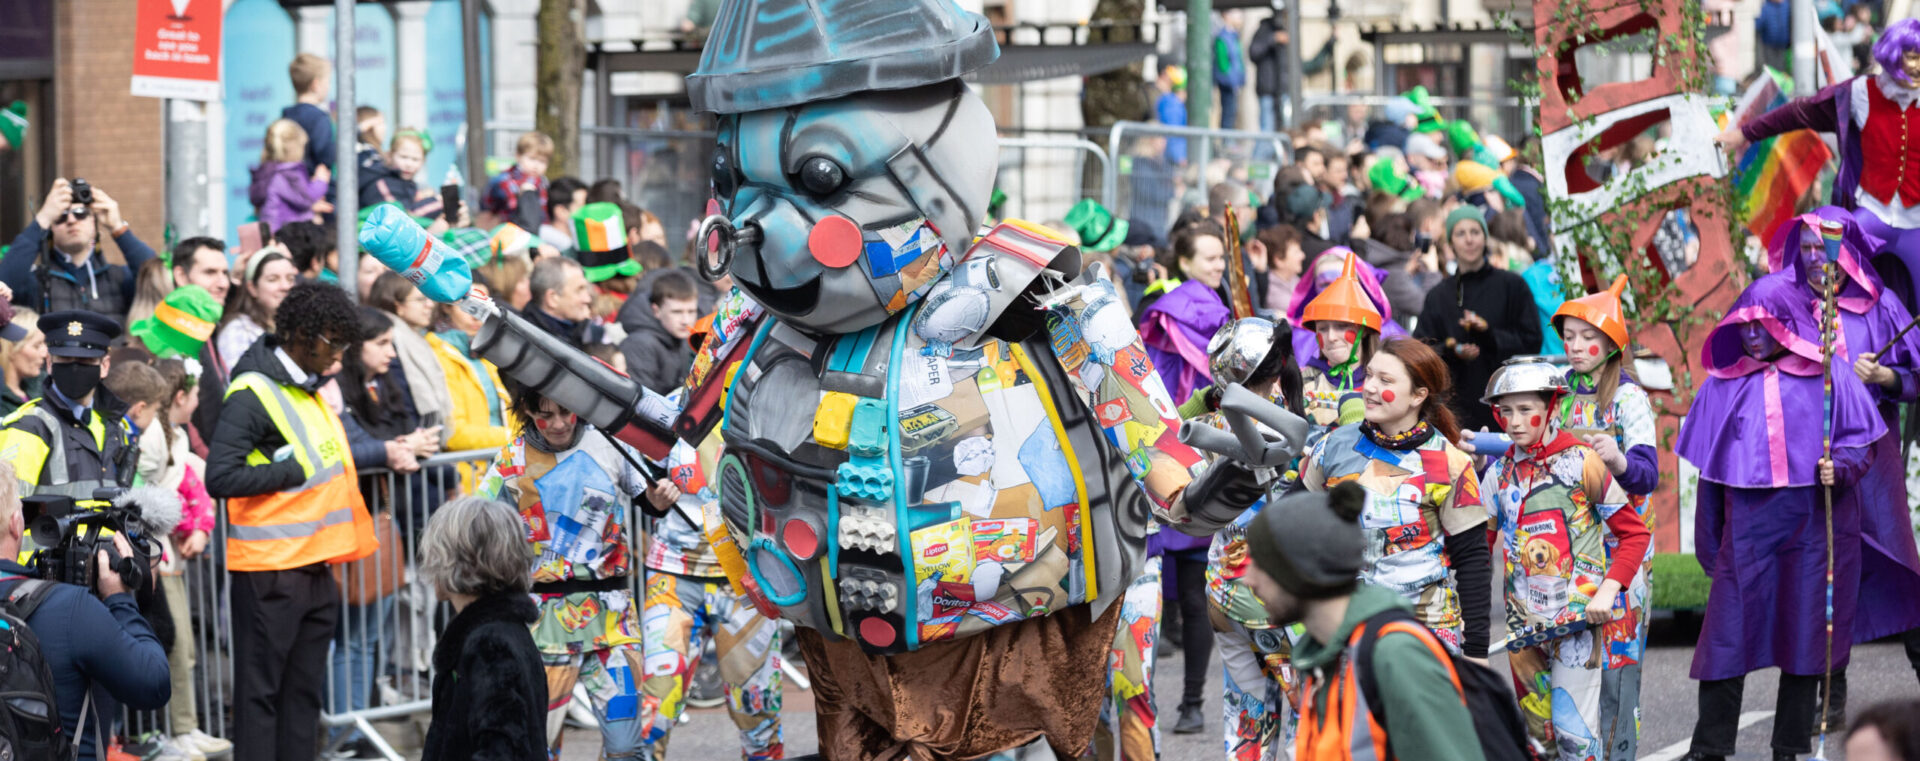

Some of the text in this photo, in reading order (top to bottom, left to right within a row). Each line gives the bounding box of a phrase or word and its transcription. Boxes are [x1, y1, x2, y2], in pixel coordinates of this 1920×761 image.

[725, 308, 755, 338] ARIEL
[926, 351, 941, 385] APER
[925, 545, 947, 556] Lipton
[922, 562, 951, 573] YELLOW
[933, 596, 971, 607] Doritos
[973, 601, 1004, 617] Colgate
[1435, 627, 1459, 648] ARIEL
